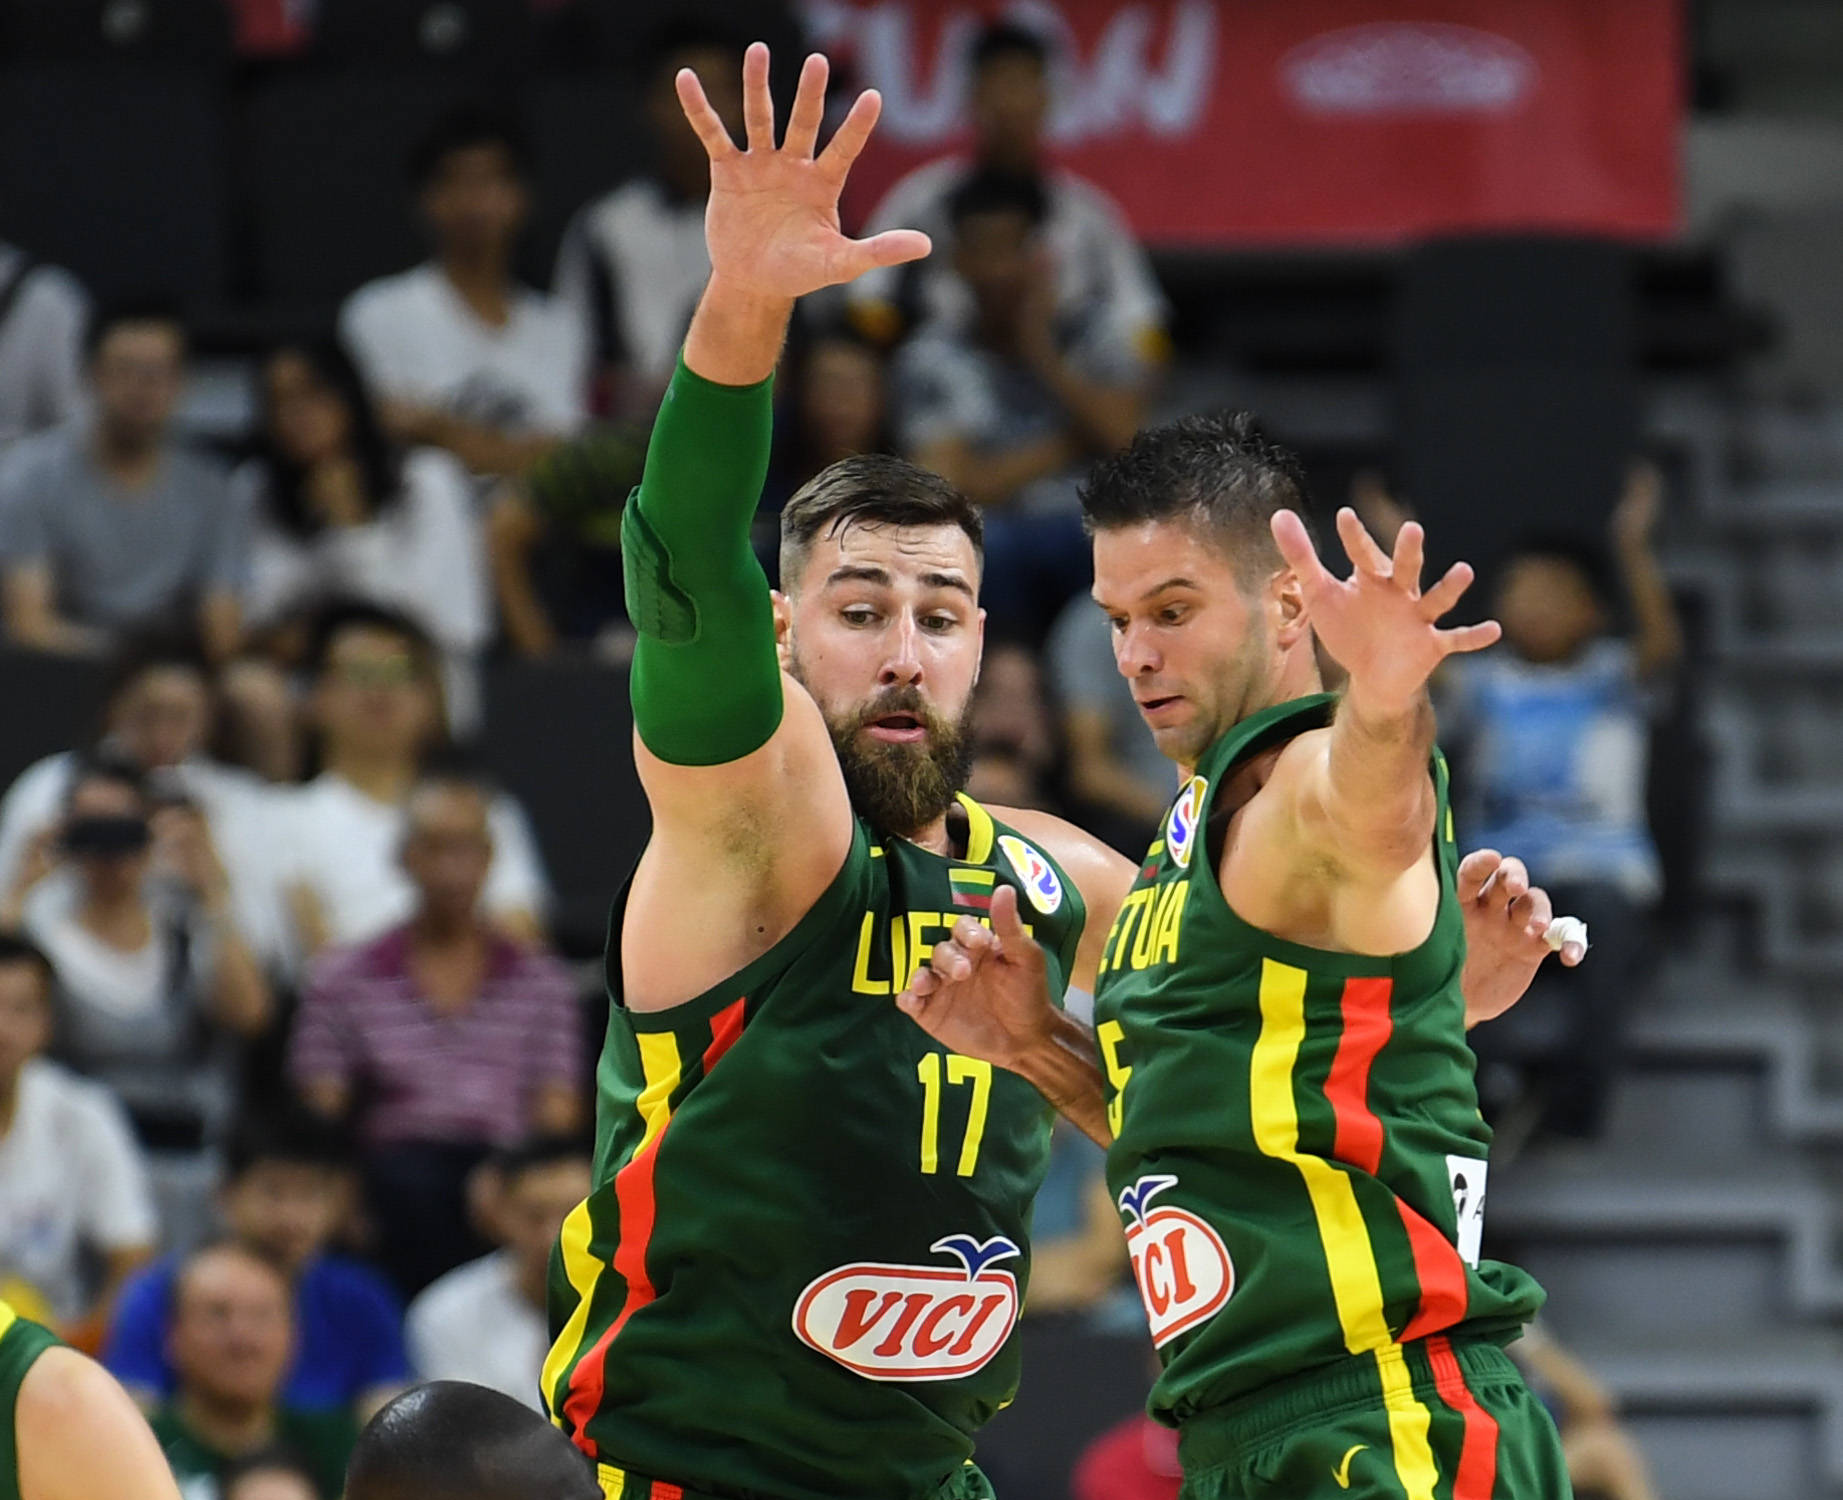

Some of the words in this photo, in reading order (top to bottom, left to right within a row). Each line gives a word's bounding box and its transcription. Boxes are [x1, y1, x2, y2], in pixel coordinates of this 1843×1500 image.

[918, 1052, 992, 1176] 17
[1132, 1228, 1196, 1316] CI
[833, 1289, 1006, 1357] VICI
